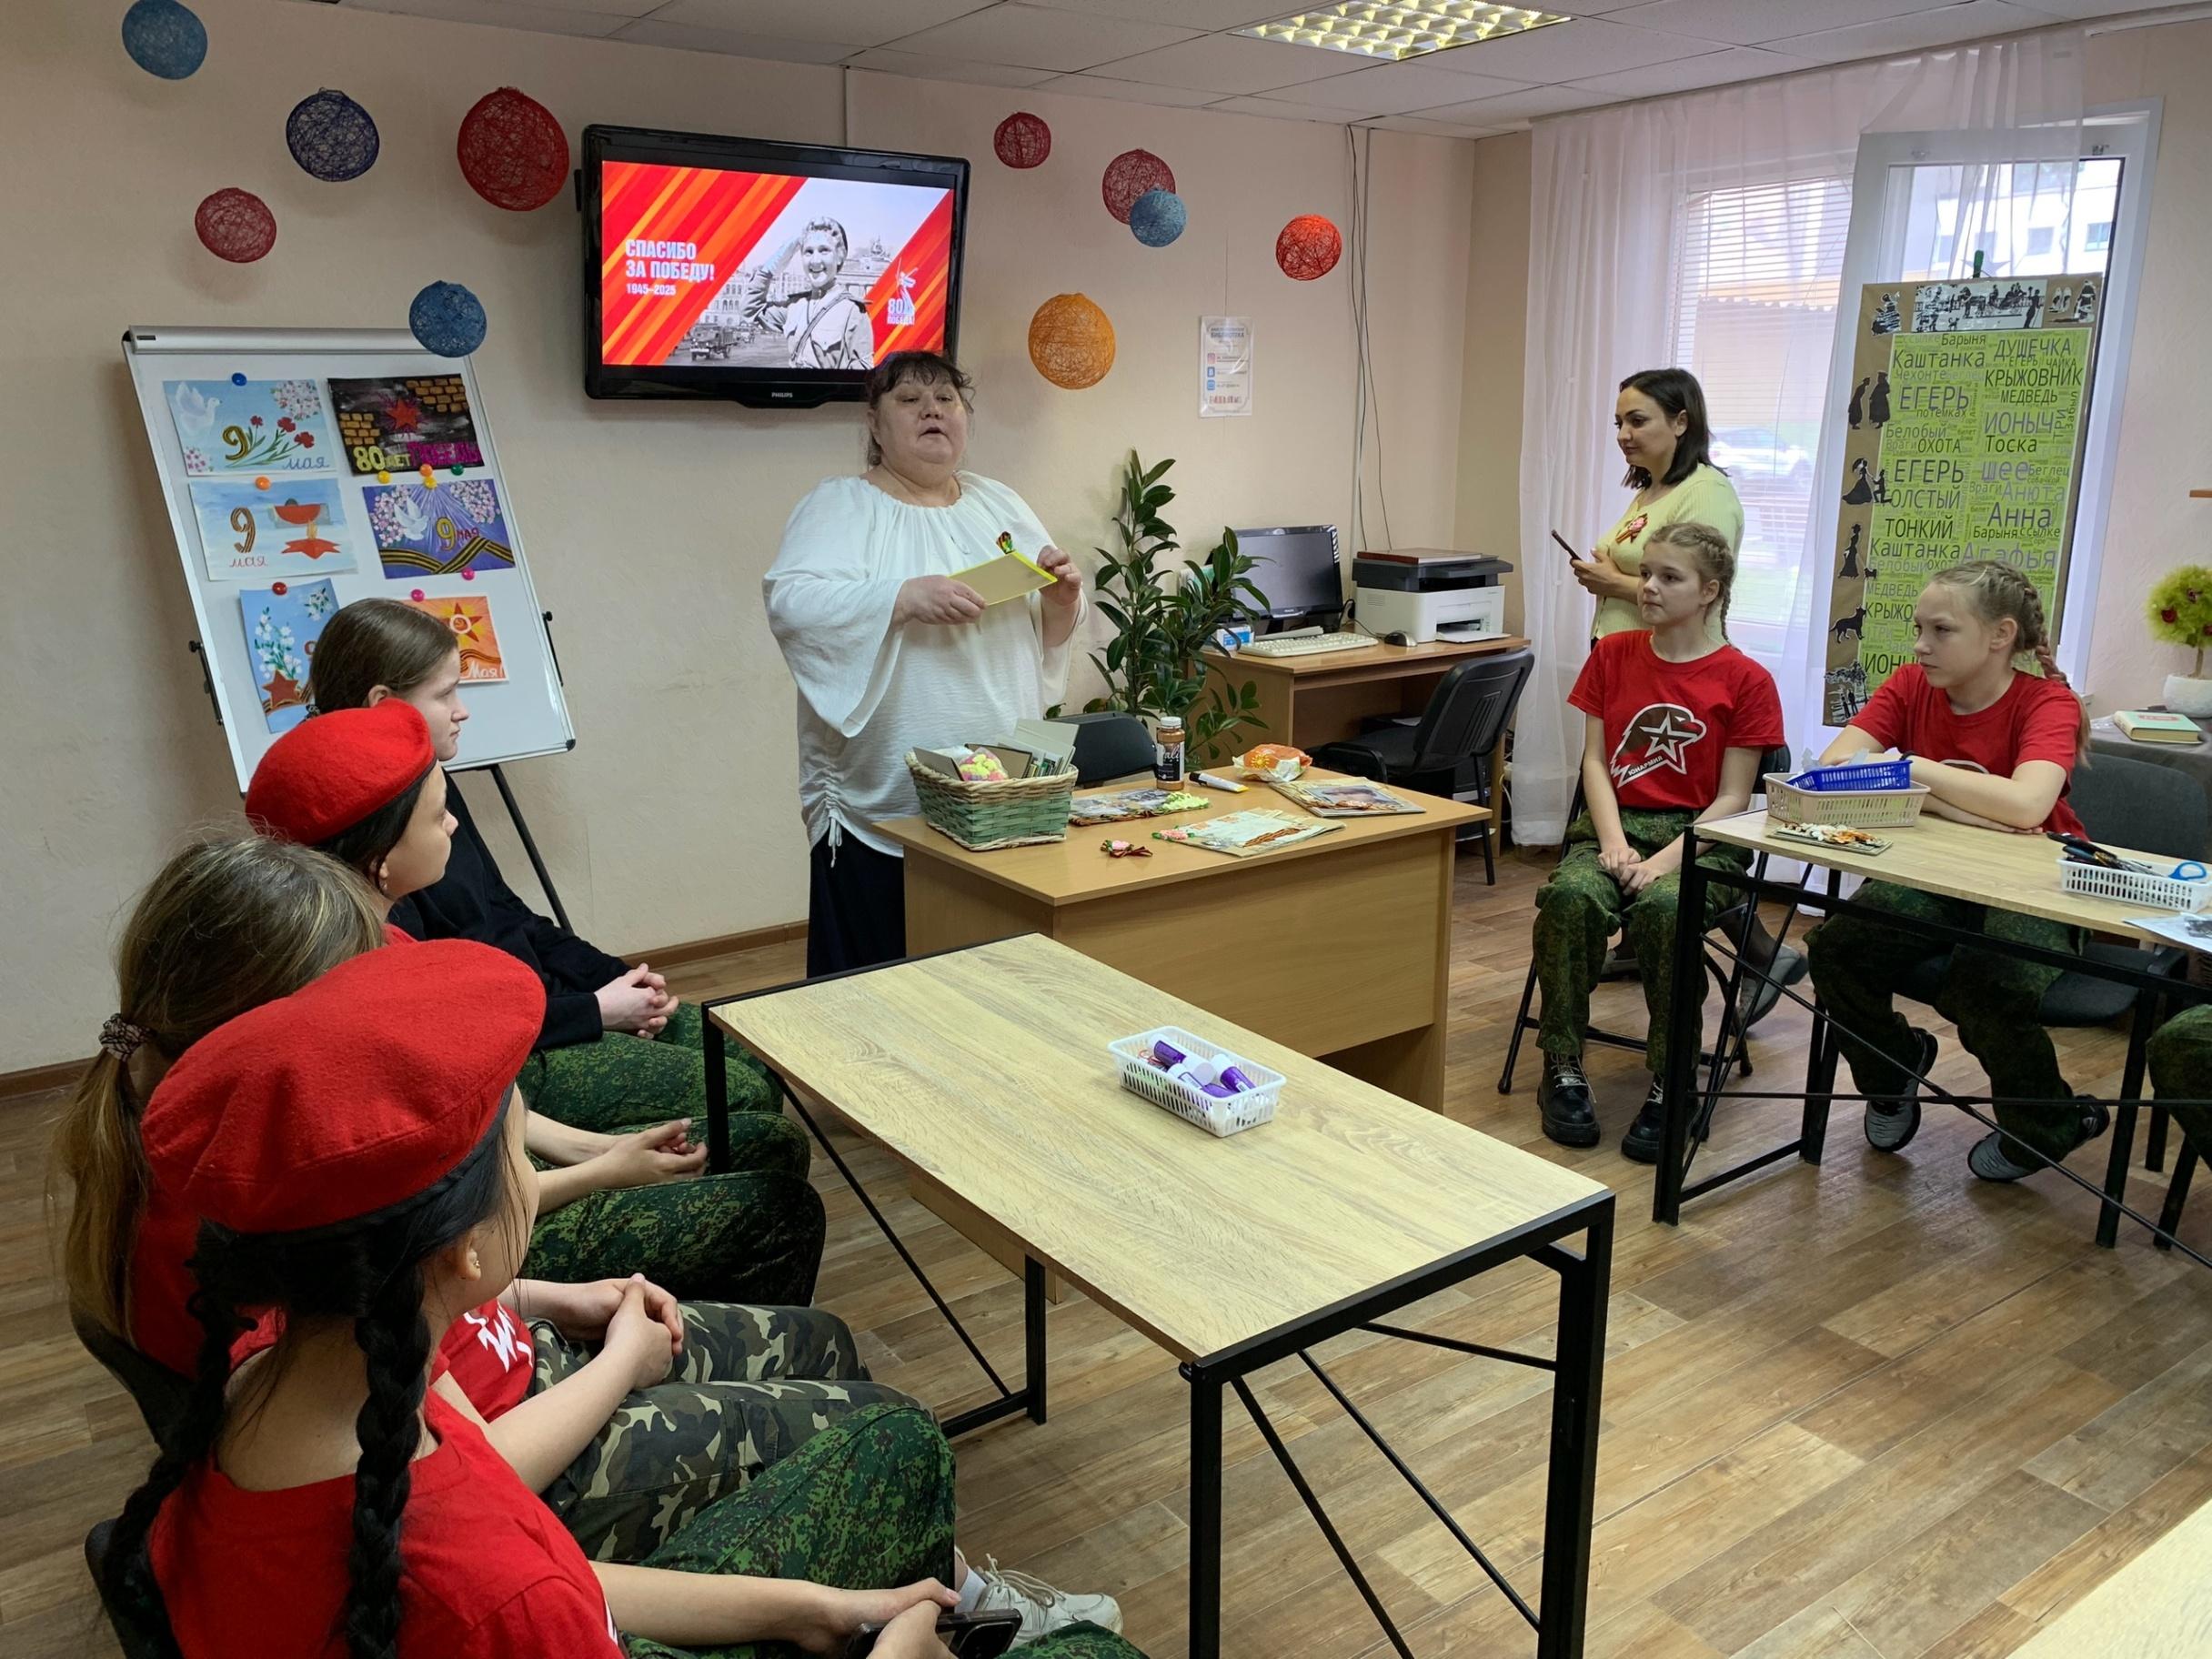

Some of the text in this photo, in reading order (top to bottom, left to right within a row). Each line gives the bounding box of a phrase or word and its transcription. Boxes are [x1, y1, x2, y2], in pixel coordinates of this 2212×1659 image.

[626, 239, 697, 260] СПАСИБО
[626, 259, 715, 283] ЗА ПОБЕДУ!
[888, 298, 903, 314] 80
[1941, 333, 1986, 348] Барыня
[1994, 337, 2072, 361] ДУШЕЧКА
[1893, 349, 1986, 369] Каштанка
[1984, 367, 2083, 387] КРЫЖОВНИК
[1900, 386, 1969, 409] ЕГЕРЬ
[2001, 389, 2058, 406] МЕДВЕДЬ
[2066, 391, 2077, 429] Забыл
[1985, 412, 2054, 434] ИОНЫЧ
[2053, 409, 2066, 444] ТРИ
[222, 426, 248, 460] 9
[1917, 438, 1962, 453] ОХОТА
[1986, 435, 2037, 453] Тоска
[283, 457, 329, 469] мая
[353, 446, 386, 471] 80
[1895, 459, 1964, 483] ЕГЕРЬ
[2001, 480, 2065, 501] Анюта
[1987, 501, 2052, 528] Анна
[230, 508, 256, 553] 9
[436, 517, 456, 551] 9
[1885, 515, 1954, 538] ТОНКИЙ
[1973, 526, 2018, 542] Барыня
[1870, 538, 1961, 559] Каштанка
[1867, 582, 1918, 598] МЕДВЕДЬ
[1865, 602, 1917, 620] КРЫЖО
[1628, 755, 1664, 776] ЮНАРМИЯ
